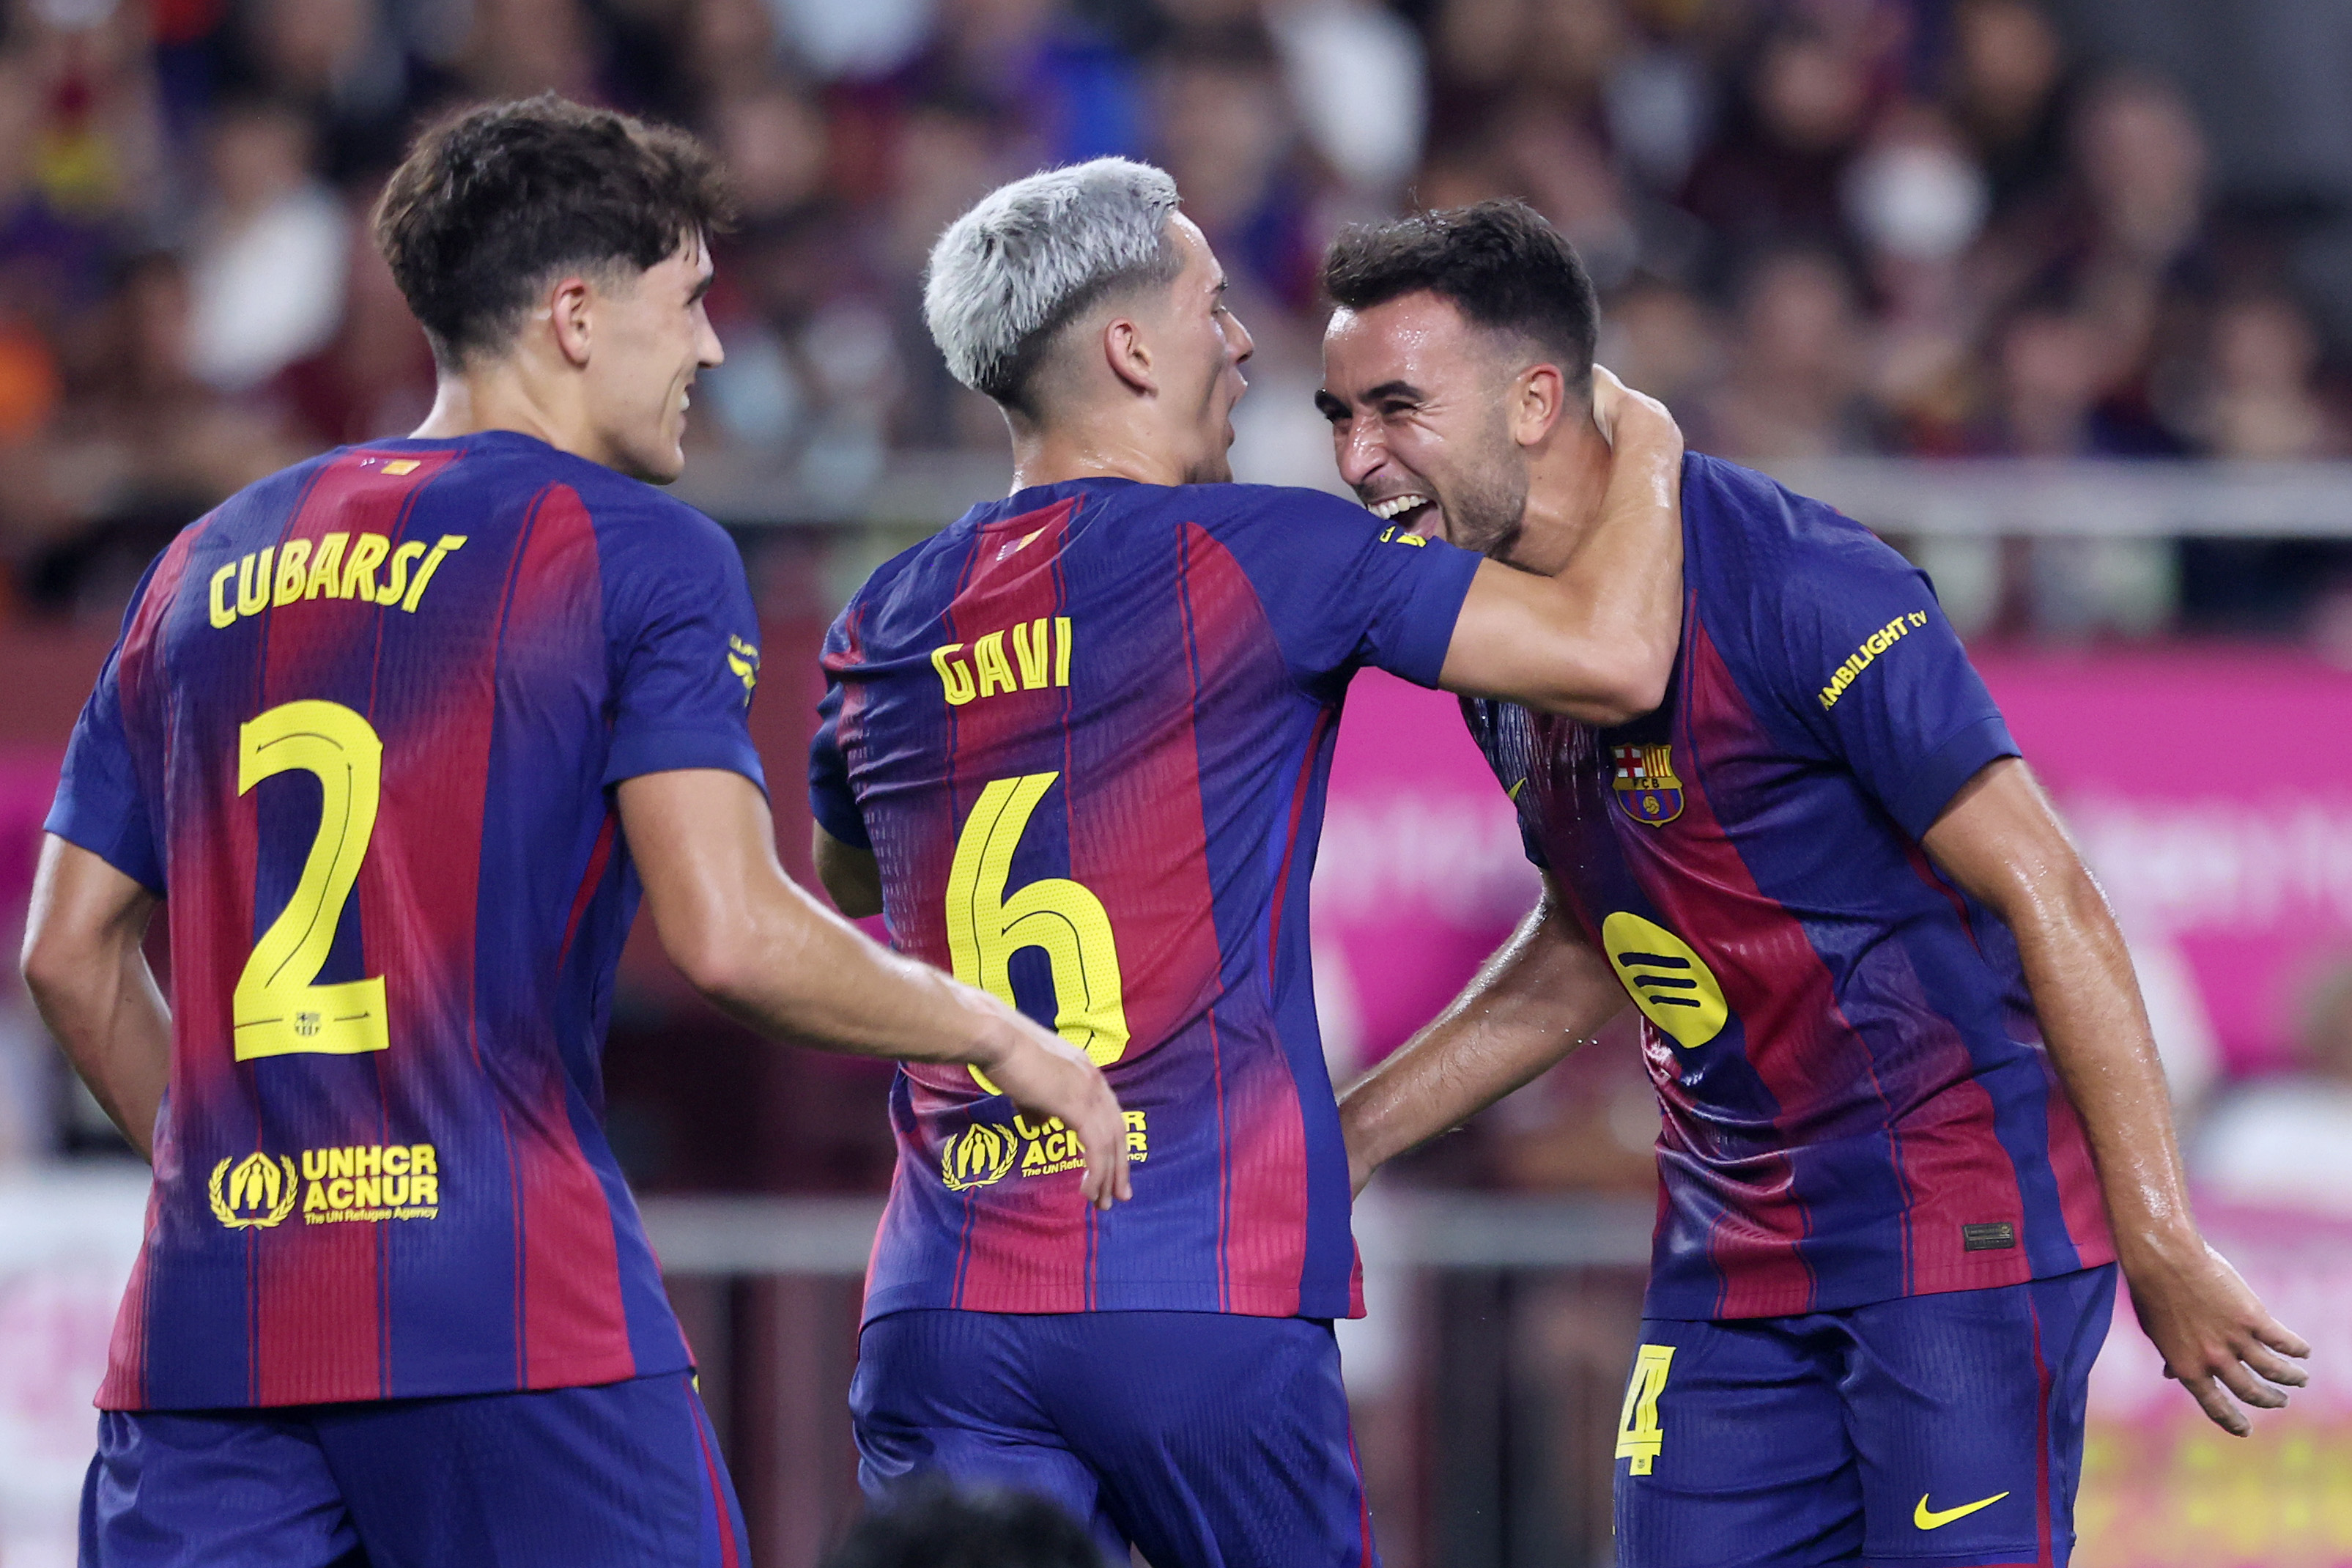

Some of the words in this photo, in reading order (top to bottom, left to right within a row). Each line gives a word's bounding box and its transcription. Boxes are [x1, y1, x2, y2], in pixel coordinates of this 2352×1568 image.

[209, 531, 468, 629] CUBARSÍ
[931, 617, 1072, 706] GAVI
[1818, 616, 1909, 711] AMBILIGHT
[1908, 610, 1928, 627] tv
[233, 699, 390, 1062] 2
[945, 771, 1131, 1096] 6
[302, 1143, 438, 1181] UNHCR
[1021, 1129, 1147, 1168] ACNR
[1022, 1167, 1041, 1178] The
[1042, 1163, 1059, 1175] UN
[1059, 1158, 1087, 1172] Refu
[303, 1175, 439, 1213] ACNUR
[305, 1212, 325, 1226] The
[326, 1210, 344, 1223] UN
[392, 1206, 439, 1221] Agency
[1614, 1344, 1677, 1476] 4
